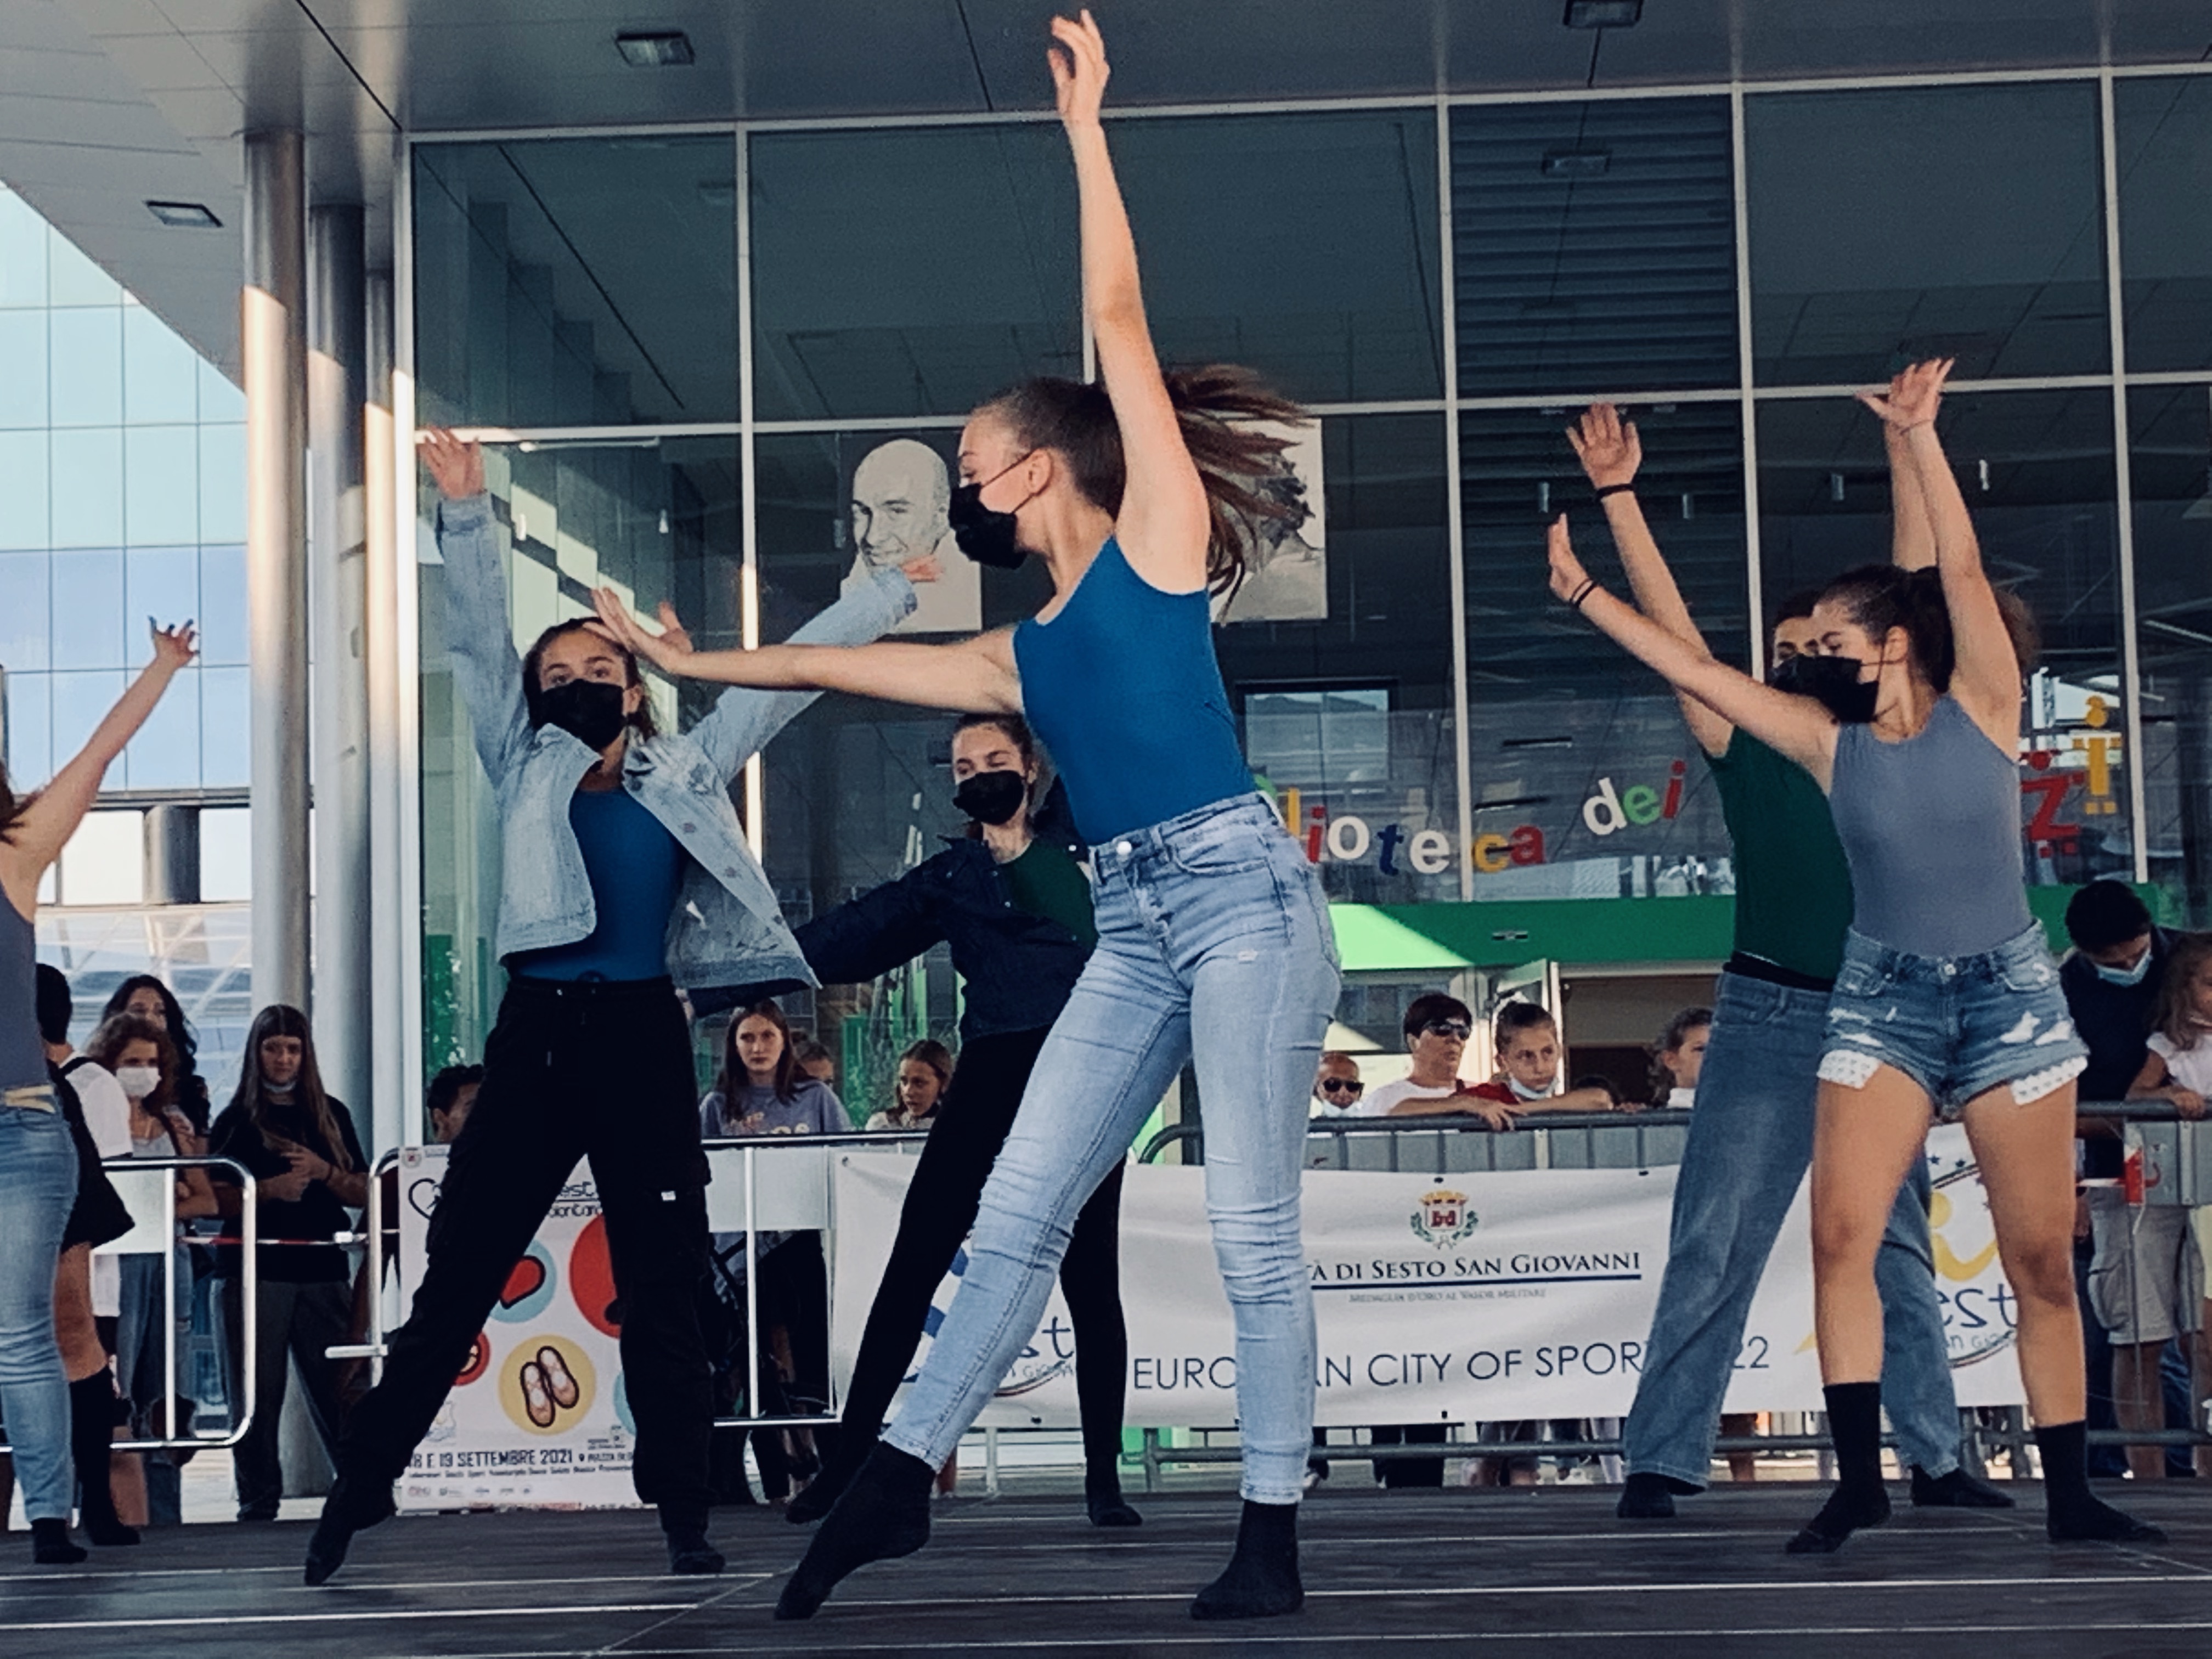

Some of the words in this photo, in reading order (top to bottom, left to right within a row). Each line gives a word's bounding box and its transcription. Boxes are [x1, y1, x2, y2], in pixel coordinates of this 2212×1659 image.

[1583, 759, 1686, 836] dei
[1336, 1263, 1362, 1280] DI
[1454, 1257, 1502, 1277] SAN
[1511, 1252, 1640, 1274] GIOVANNI
[1368, 1353, 1451, 1386] CITY
[1467, 1349, 1522, 1380] OF
[1534, 1340, 1648, 1378] SPOR
[457, 1449, 536, 1467] SETTEMBRE
[540, 1448, 573, 1464] 2021
